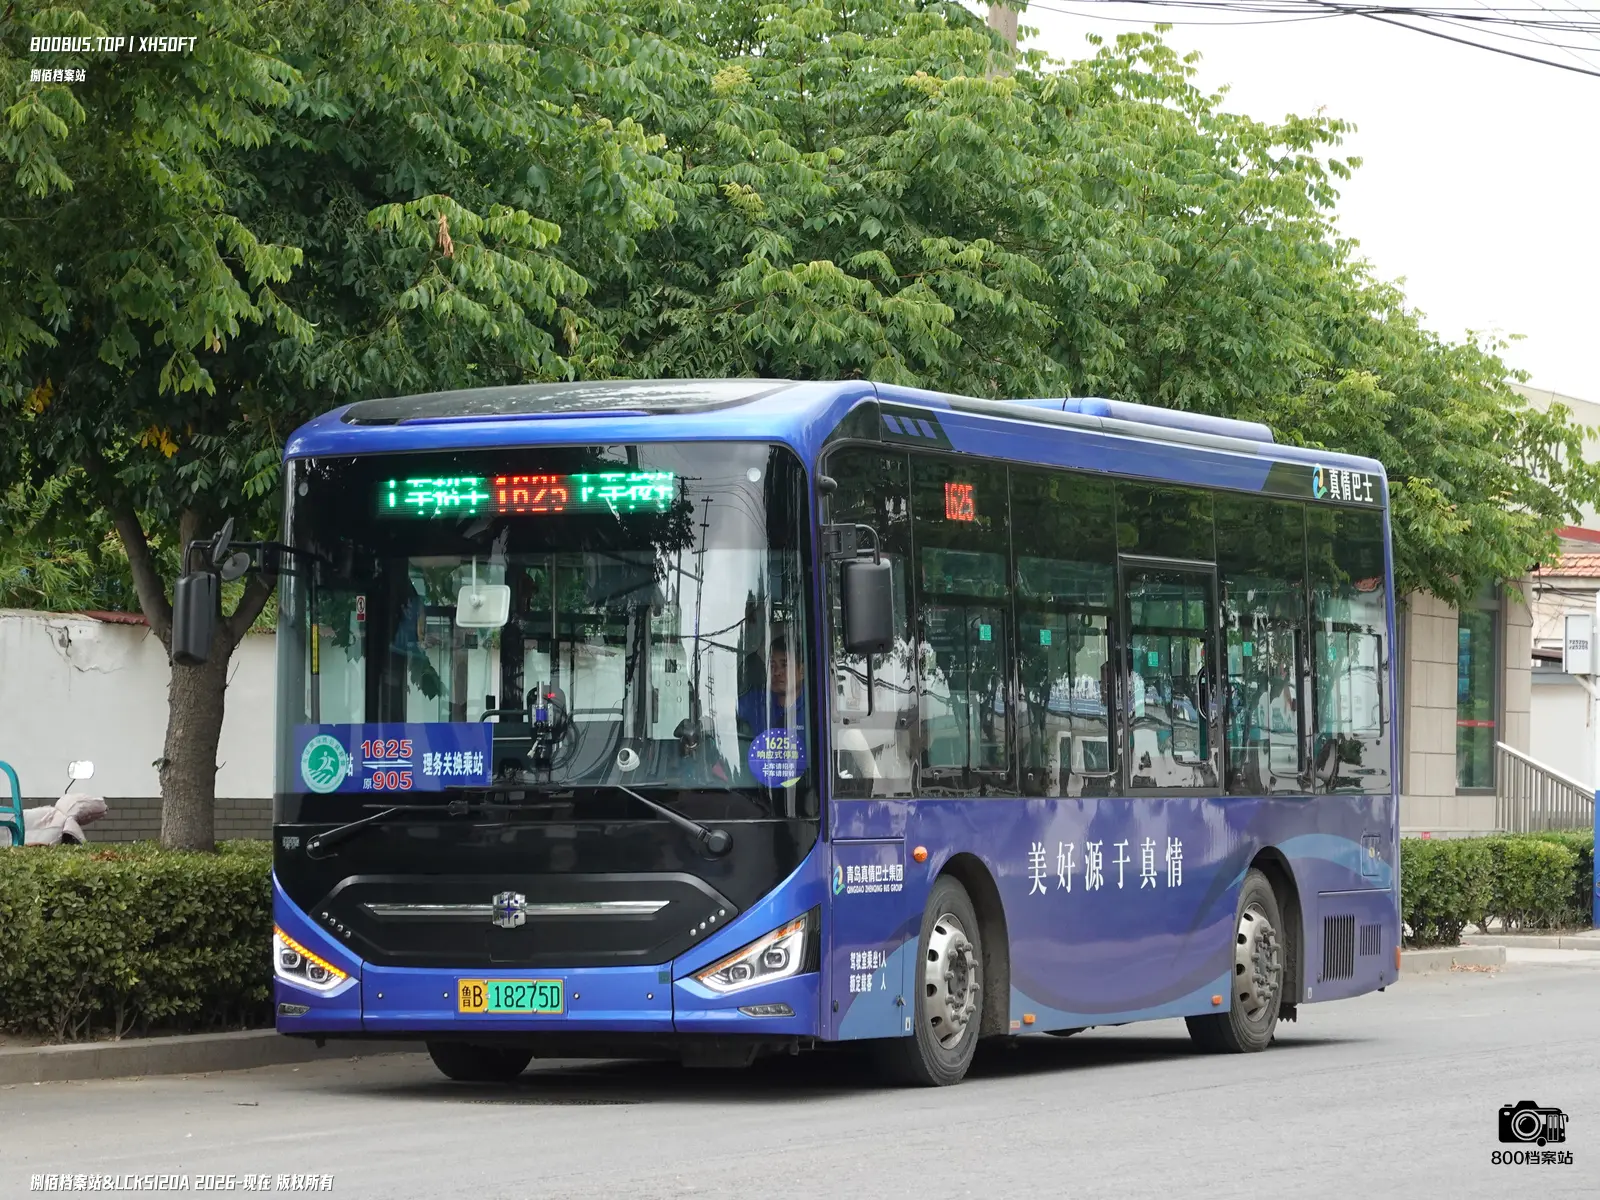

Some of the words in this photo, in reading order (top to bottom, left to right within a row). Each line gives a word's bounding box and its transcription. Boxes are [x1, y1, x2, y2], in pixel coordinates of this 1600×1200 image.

[1329, 468, 1374, 502] 真情巴士
[945, 482, 975, 522] 1625
[360, 739, 413, 758] 1625
[422, 751, 484, 777] 理务关换乘站
[847, 865, 903, 883] 青岛真情巴士集团
[1027, 836, 1184, 896] 美好源于真情
